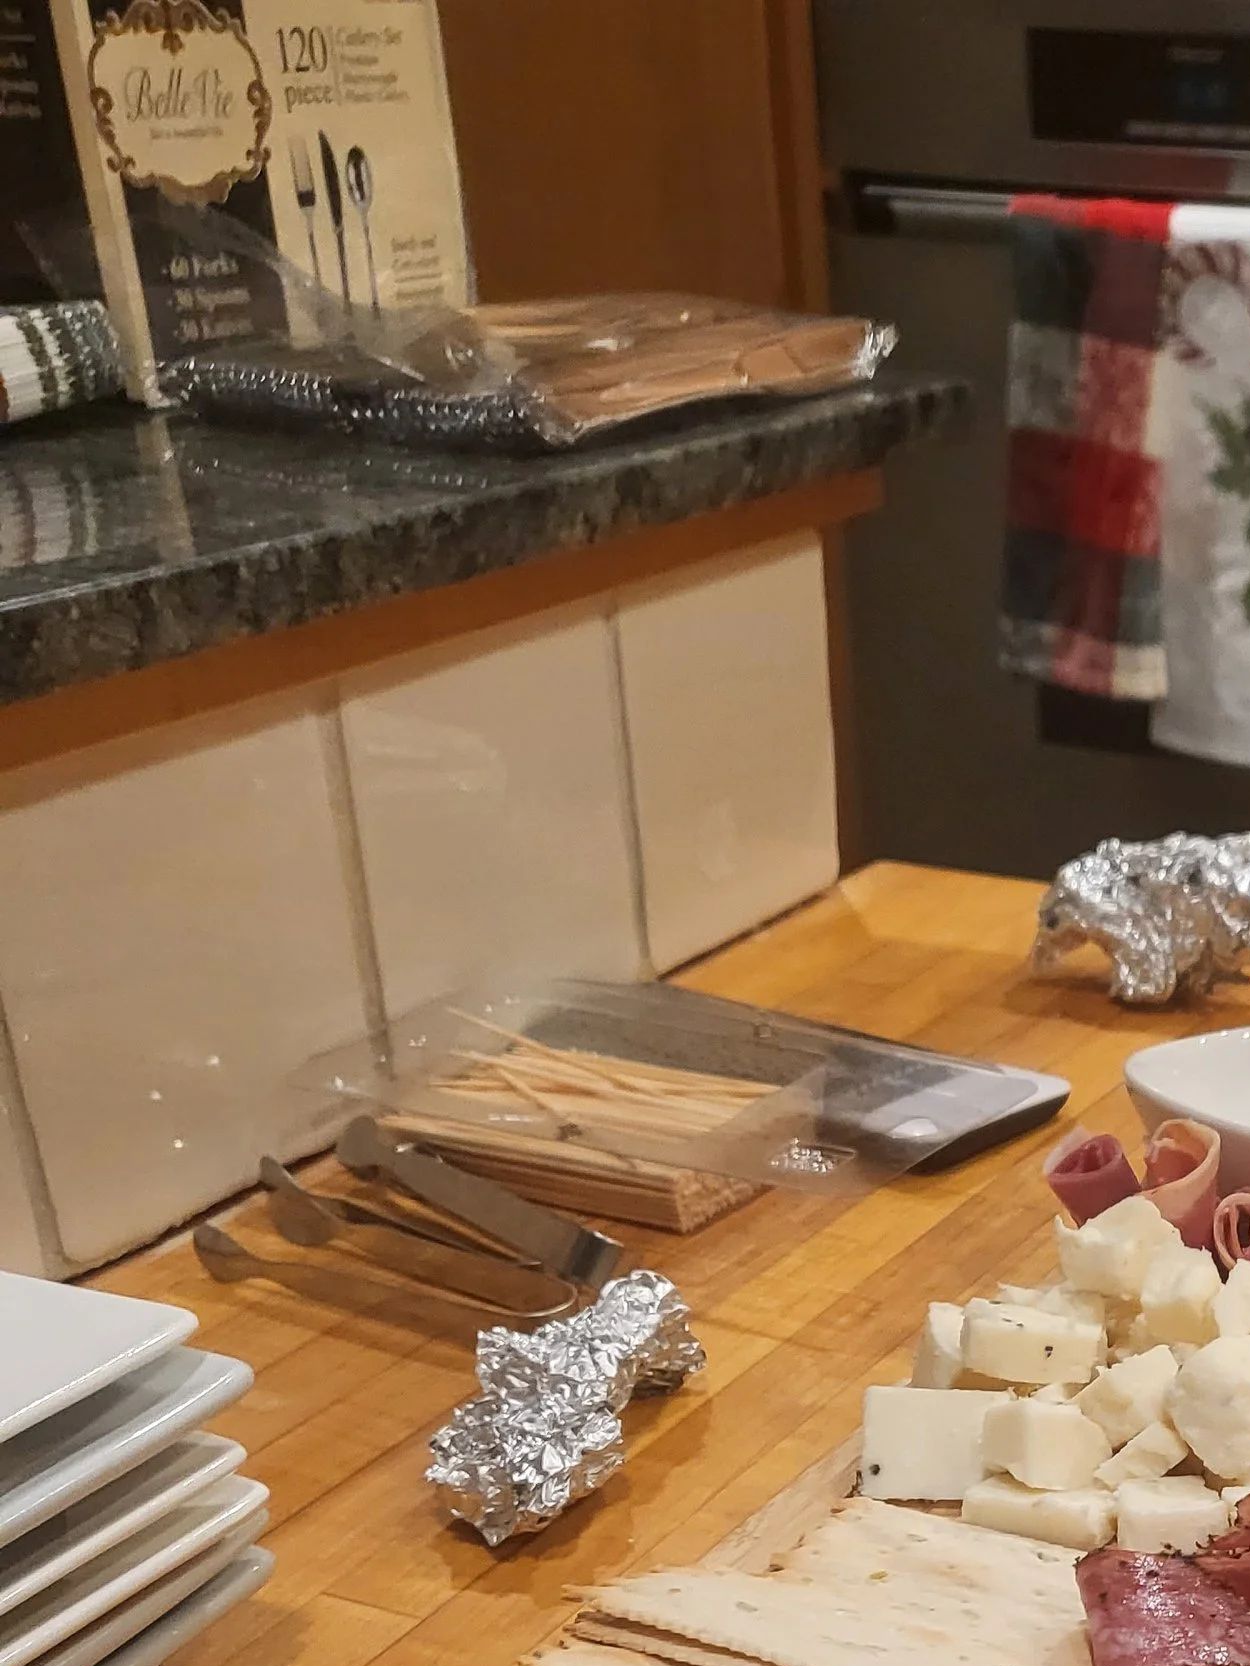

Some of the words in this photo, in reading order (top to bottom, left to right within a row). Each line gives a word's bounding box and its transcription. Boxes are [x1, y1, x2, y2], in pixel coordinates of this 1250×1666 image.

[276, 25, 328, 73] 120
[122, 66, 194, 122] Belle
[195, 66, 234, 119] Vie
[284, 85, 333, 113] piece
